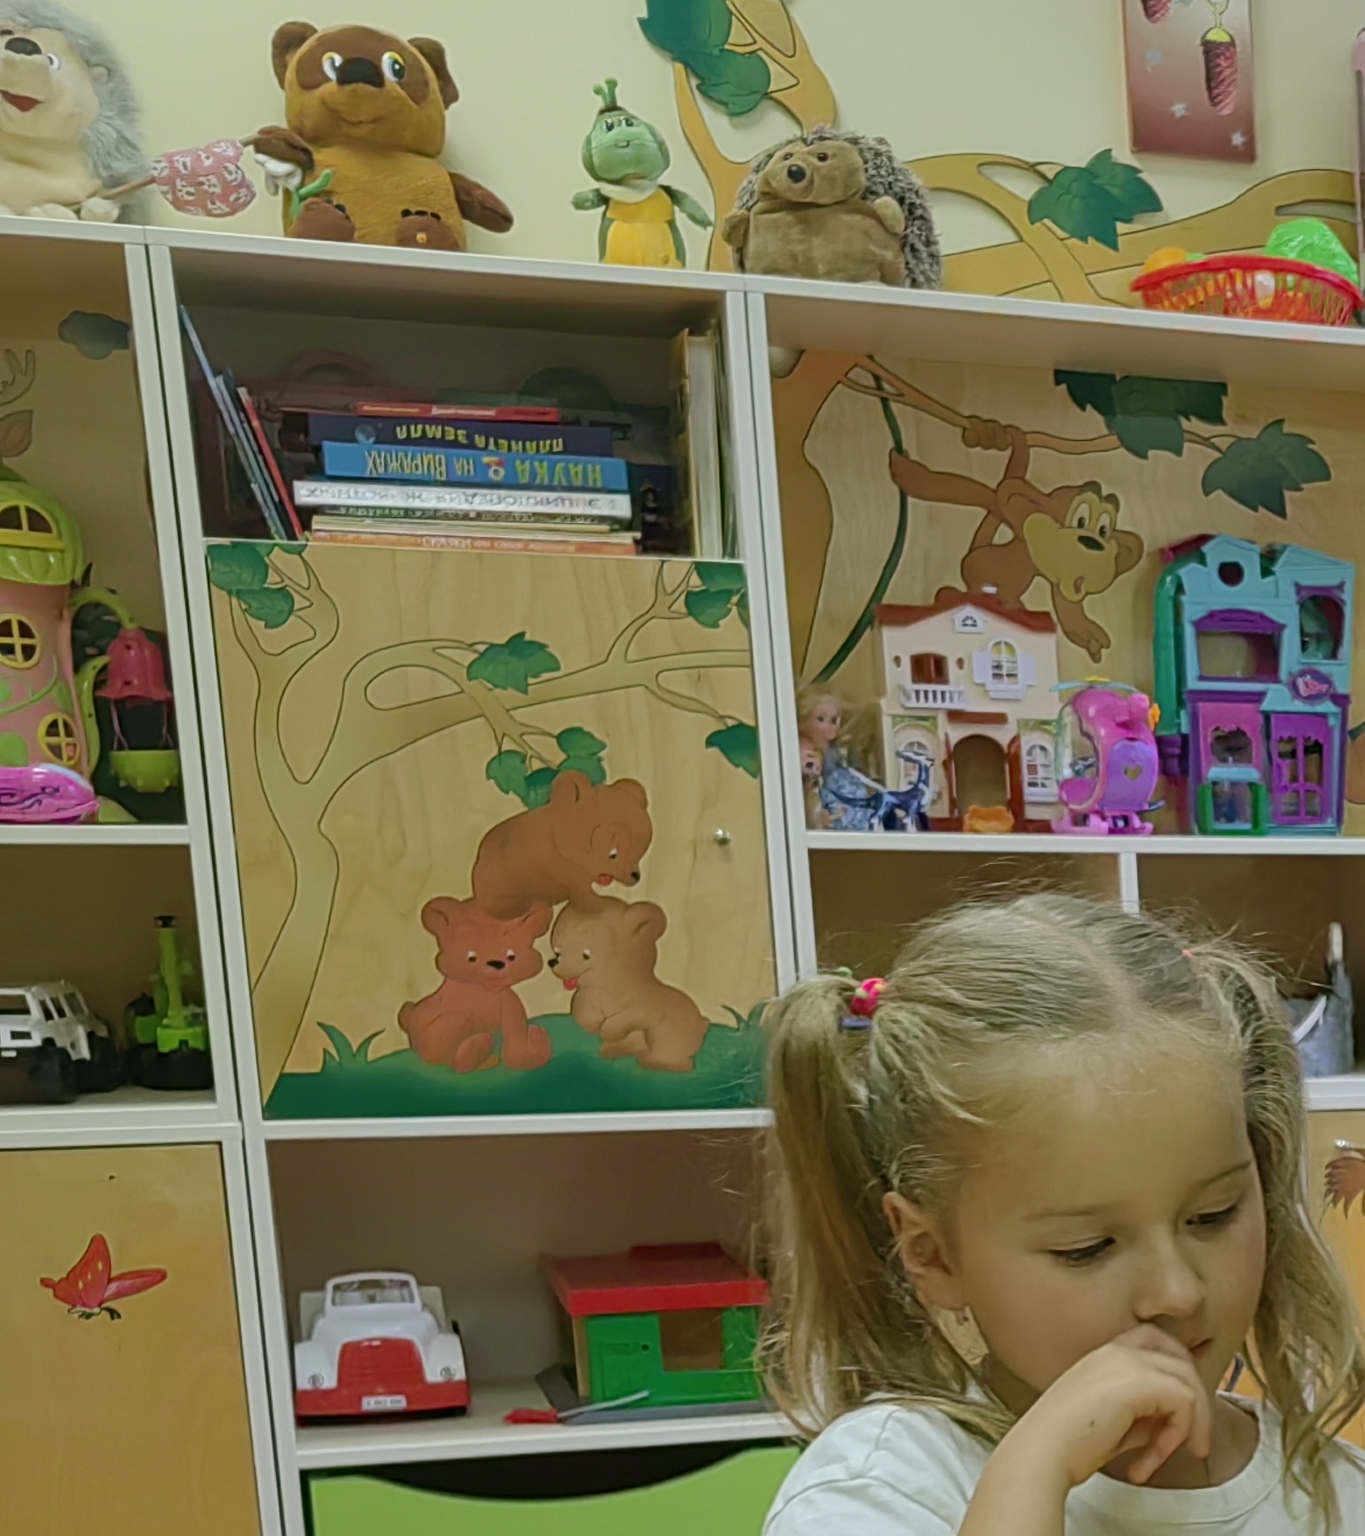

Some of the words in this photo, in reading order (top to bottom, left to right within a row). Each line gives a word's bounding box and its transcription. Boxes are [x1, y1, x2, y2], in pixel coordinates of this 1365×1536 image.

[396, 425, 468, 444] ЗЕМЛЯ
[475, 433, 564, 454] ПЛАНЕТА
[365, 450, 447, 481] ВИРАЖАХ
[453, 456, 475, 476] НА
[514, 459, 603, 487] НАУКА
